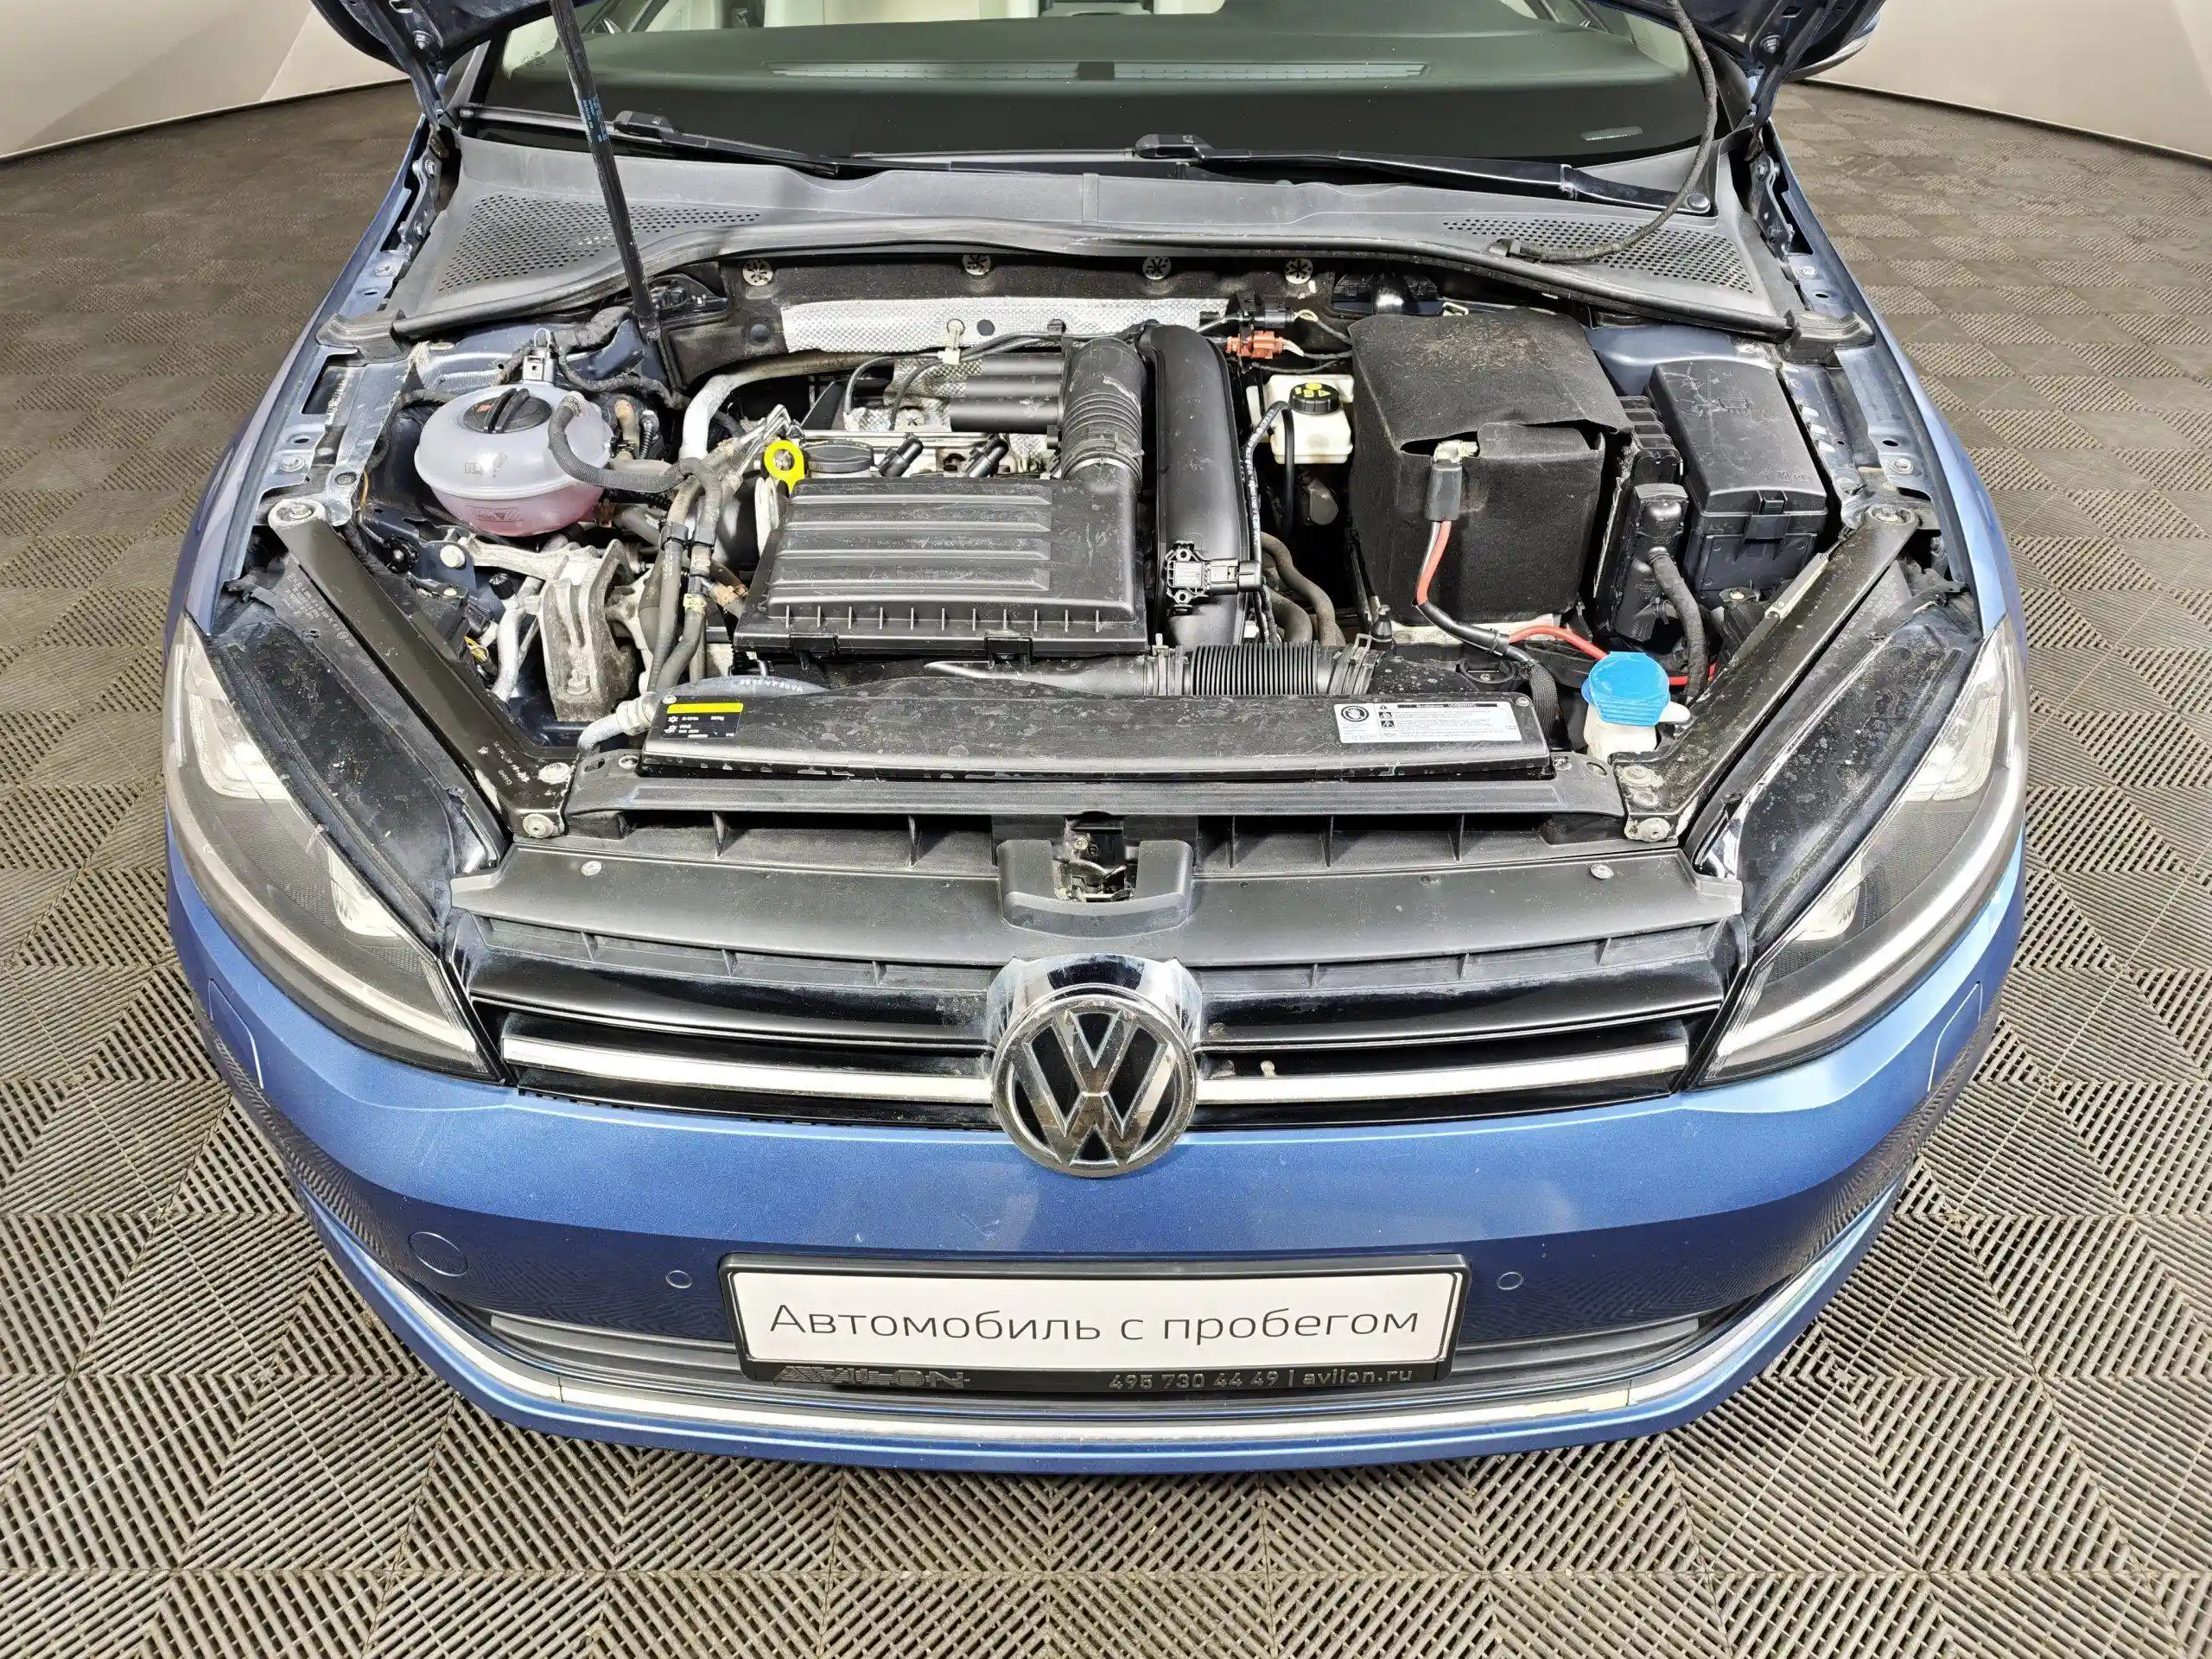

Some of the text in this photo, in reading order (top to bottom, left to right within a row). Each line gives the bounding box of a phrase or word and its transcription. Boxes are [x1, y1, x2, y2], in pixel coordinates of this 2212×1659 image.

[770, 1304, 1418, 1346] Автомобиль с пробегом
[773, 1365, 969, 1389] AVILON
[1109, 1373, 1154, 1389] 495
[1161, 1372, 1205, 1389] 730
[1212, 1371, 1243, 1388] 44
[1249, 1370, 1279, 1387] 49
[1302, 1368, 1414, 1386] avilon.ru
